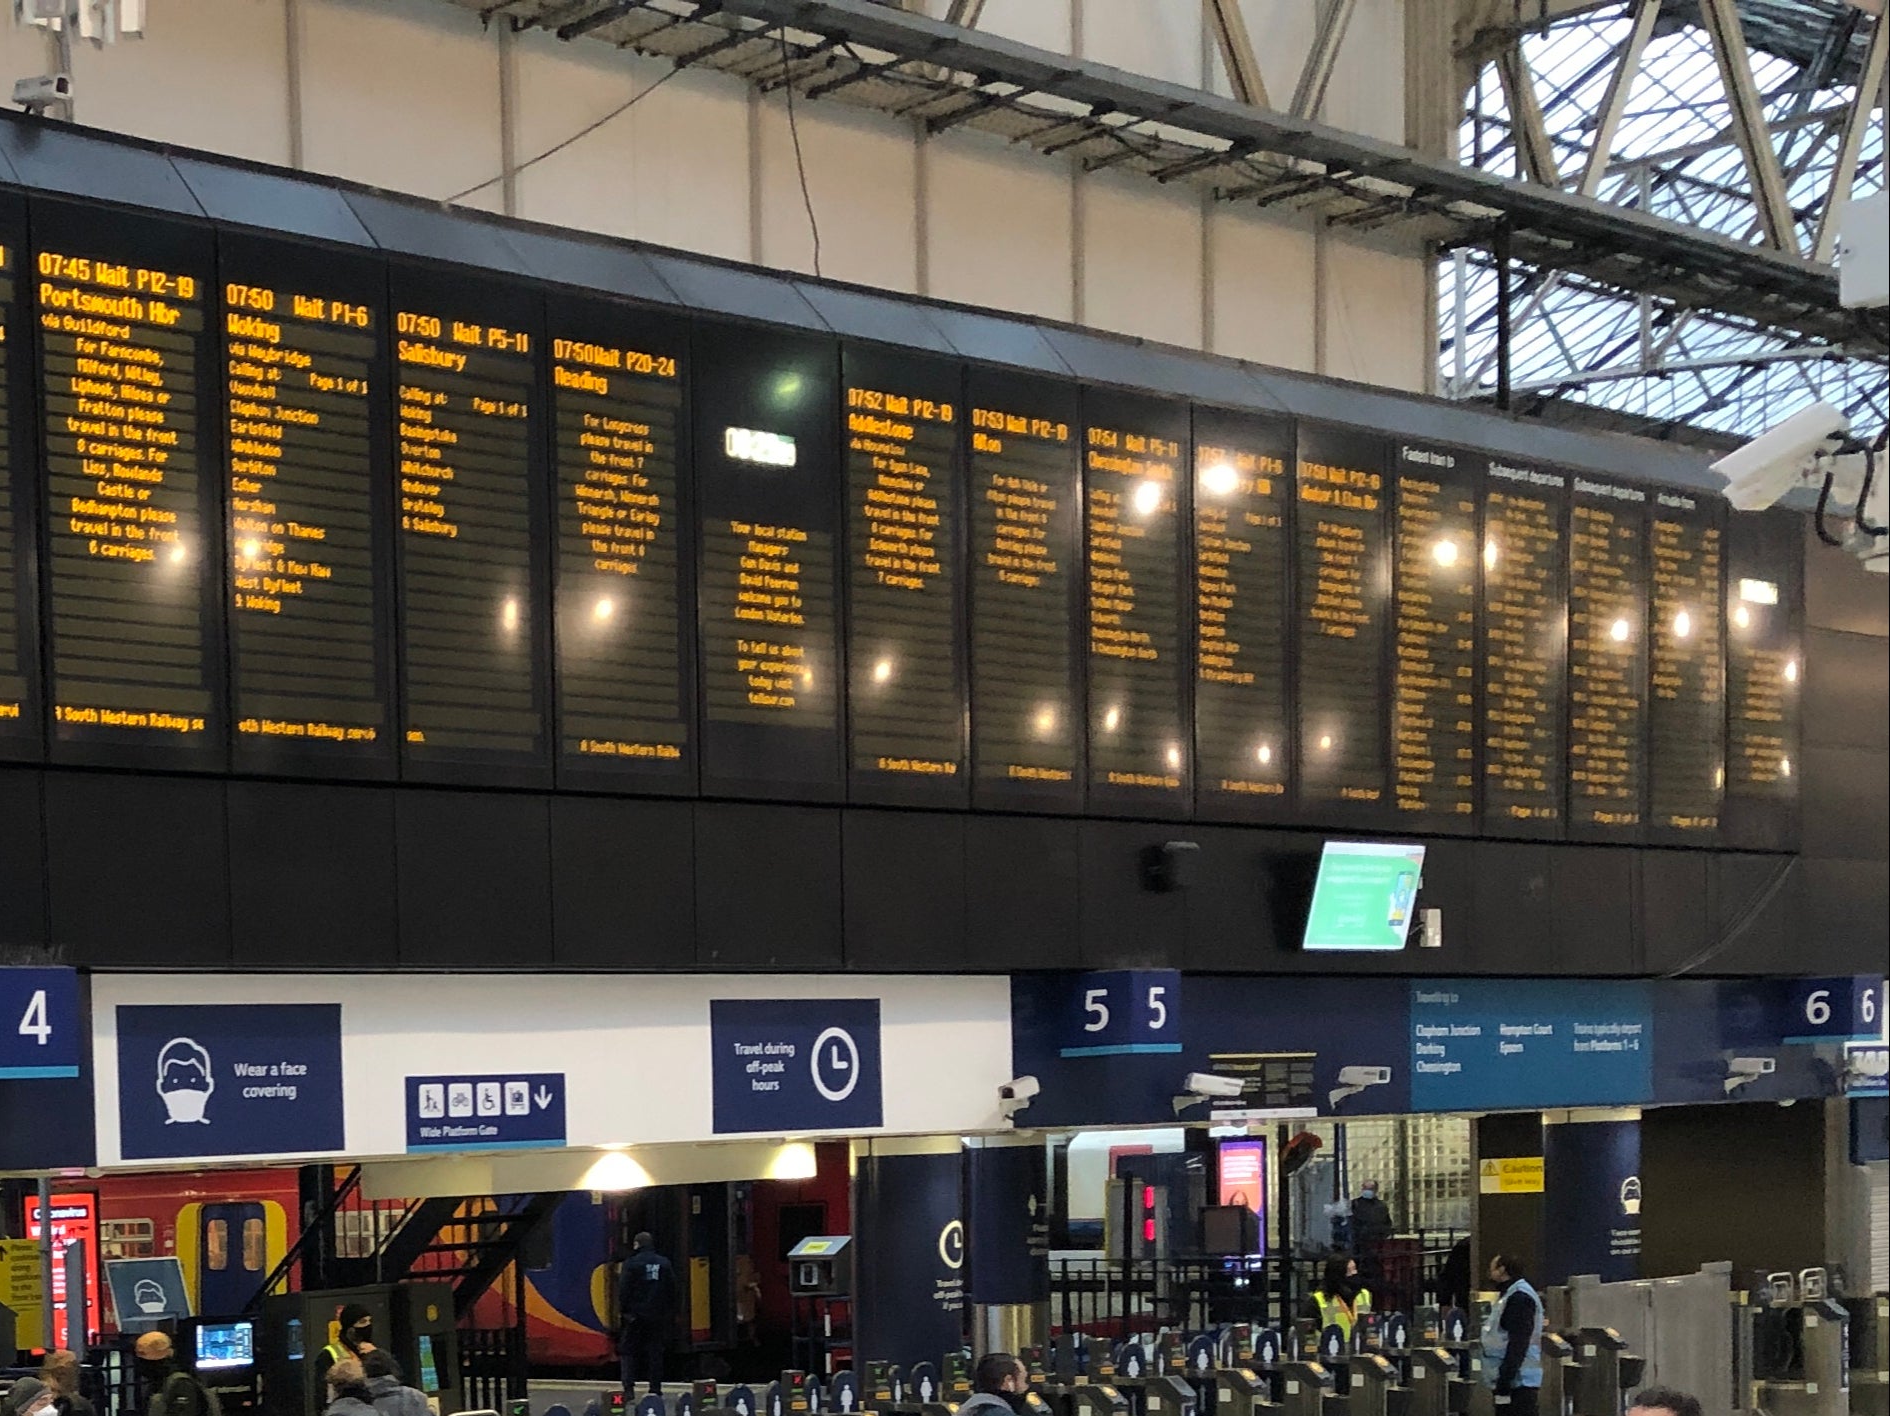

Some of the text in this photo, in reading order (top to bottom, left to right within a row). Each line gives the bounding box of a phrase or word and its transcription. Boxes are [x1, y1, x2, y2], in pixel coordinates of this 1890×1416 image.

[37, 251, 194, 299] 07:45 Wait P12-19
[38, 281, 181, 325] Portsmouth Hbr
[225, 282, 368, 327] 07:50 Wait P1-6
[61, 314, 130, 339] Guildford
[226, 312, 281, 344] Woking
[396, 311, 528, 353] 07:50 Wait P5-11
[397, 339, 466, 372] Salisbury
[625, 350, 675, 376] P20-24
[553, 364, 608, 395] Reading
[847, 387, 884, 411] 07:52
[884, 393, 909, 415] Wait
[18, 990, 52, 1045] 4
[1084, 988, 1109, 1032] 5
[1149, 986, 1166, 1029] 5
[1806, 990, 1830, 1025] 6
[1862, 988, 1875, 1022] 6
[1416, 1024, 1482, 1039] Clapham Junction
[734, 1042, 795, 1057] Travel during
[234, 1062, 307, 1076] Wear a face
[746, 1060, 785, 1075] off-peak
[242, 1084, 297, 1100] covering
[752, 1079, 780, 1091] hours
[419, 1125, 498, 1138] Wide Platform Gate
[1502, 1163, 1543, 1174] Caution
